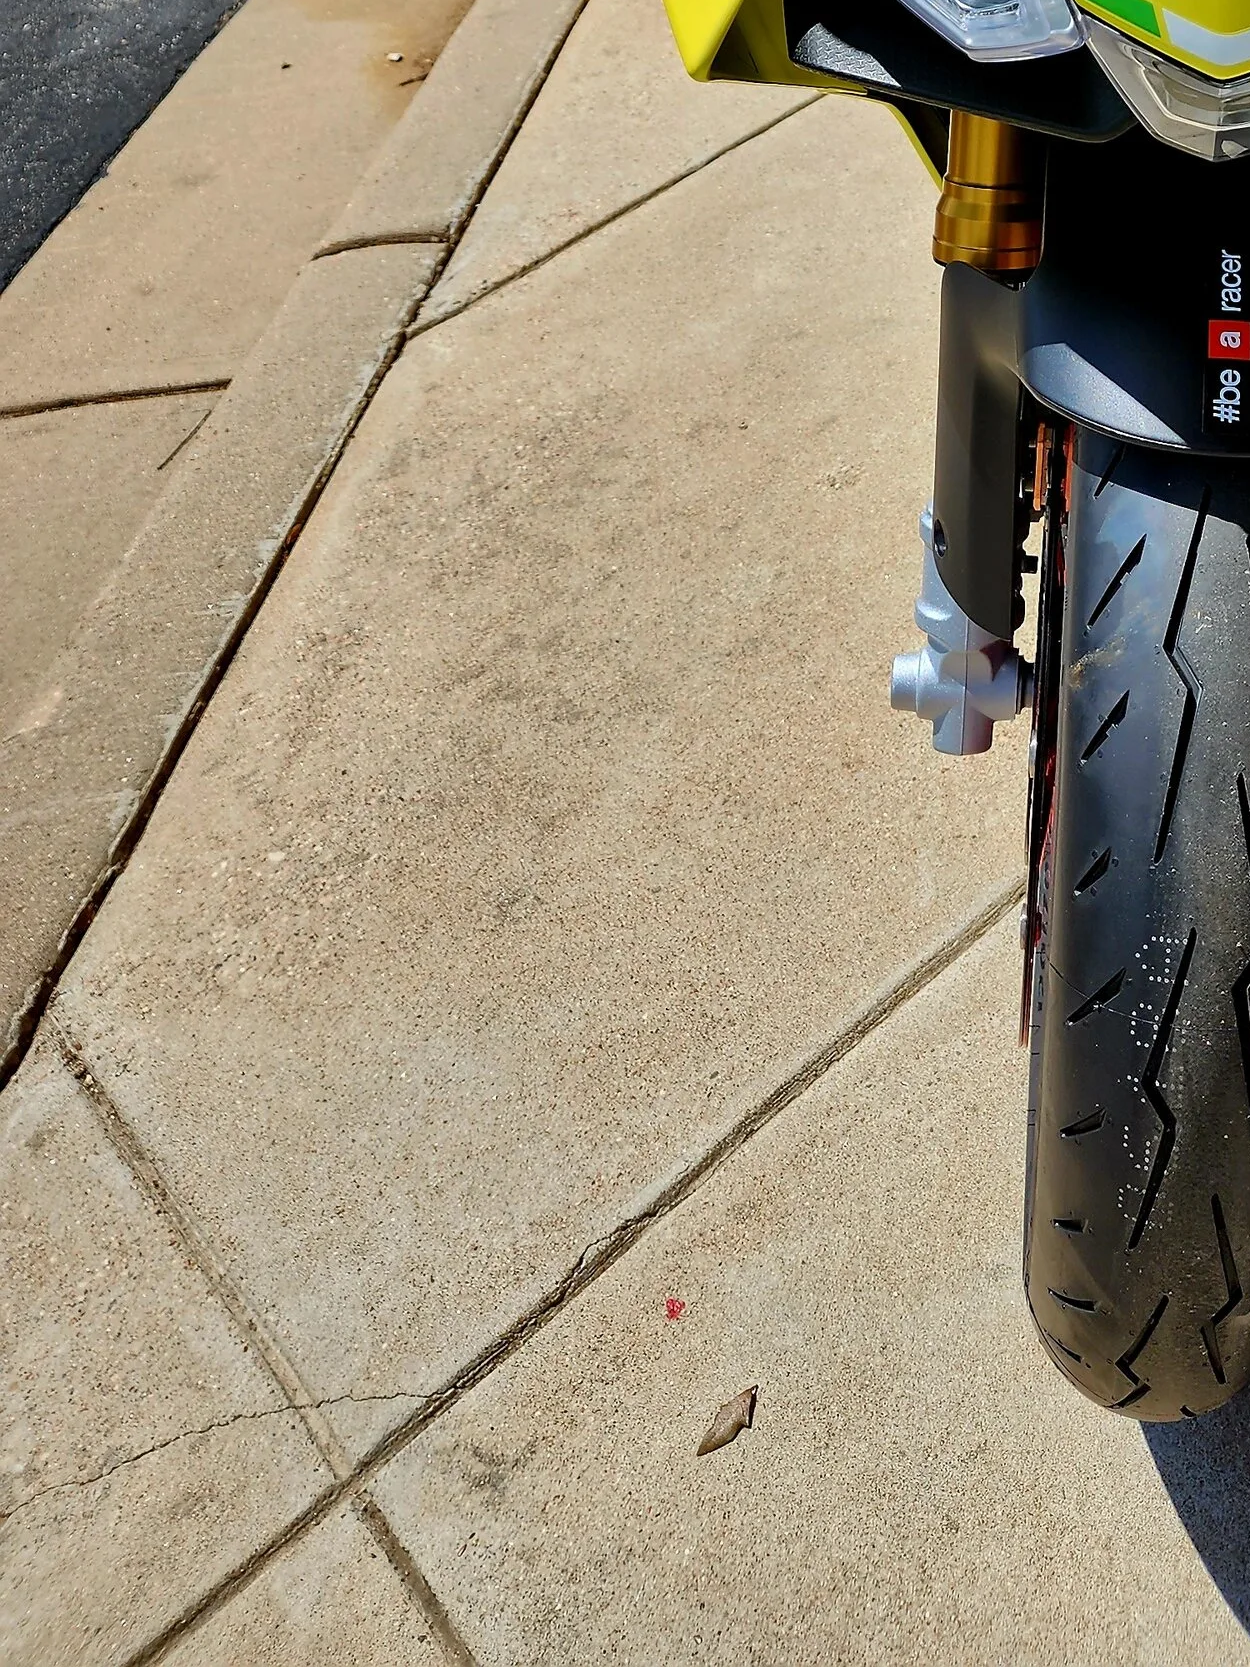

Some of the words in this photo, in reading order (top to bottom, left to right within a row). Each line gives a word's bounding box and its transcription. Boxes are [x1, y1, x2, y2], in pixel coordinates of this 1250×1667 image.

[1221, 248, 1242, 312] racer
[1219, 331, 1241, 349] a
[1212, 368, 1241, 424] #be
